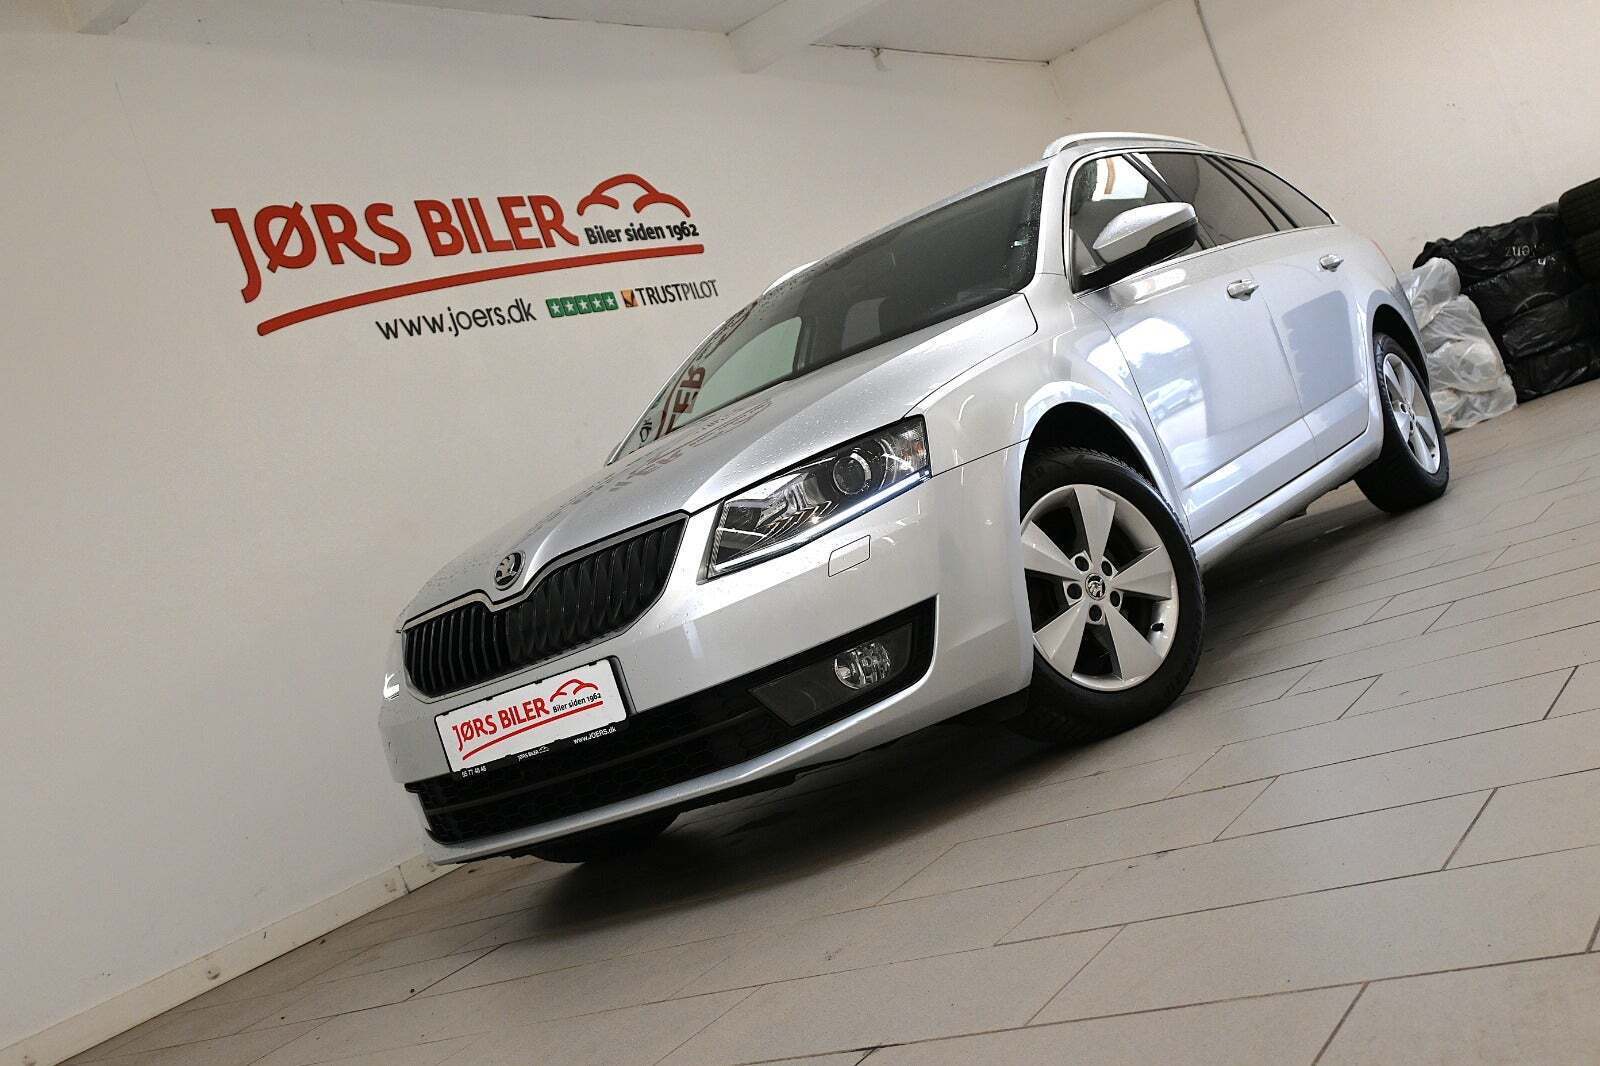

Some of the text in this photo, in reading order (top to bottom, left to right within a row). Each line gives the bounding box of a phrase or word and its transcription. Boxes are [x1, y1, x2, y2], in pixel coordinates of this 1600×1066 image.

[211, 195, 580, 303] JØRS BILER
[584, 220, 699, 245] Biler siden 1962
[634, 279, 719, 306] TRUSTPILOT
[375, 297, 537, 340] www.joers.dk
[553, 692, 602, 713] Biler siden 1962
[452, 697, 550, 752] JØRS BILER
